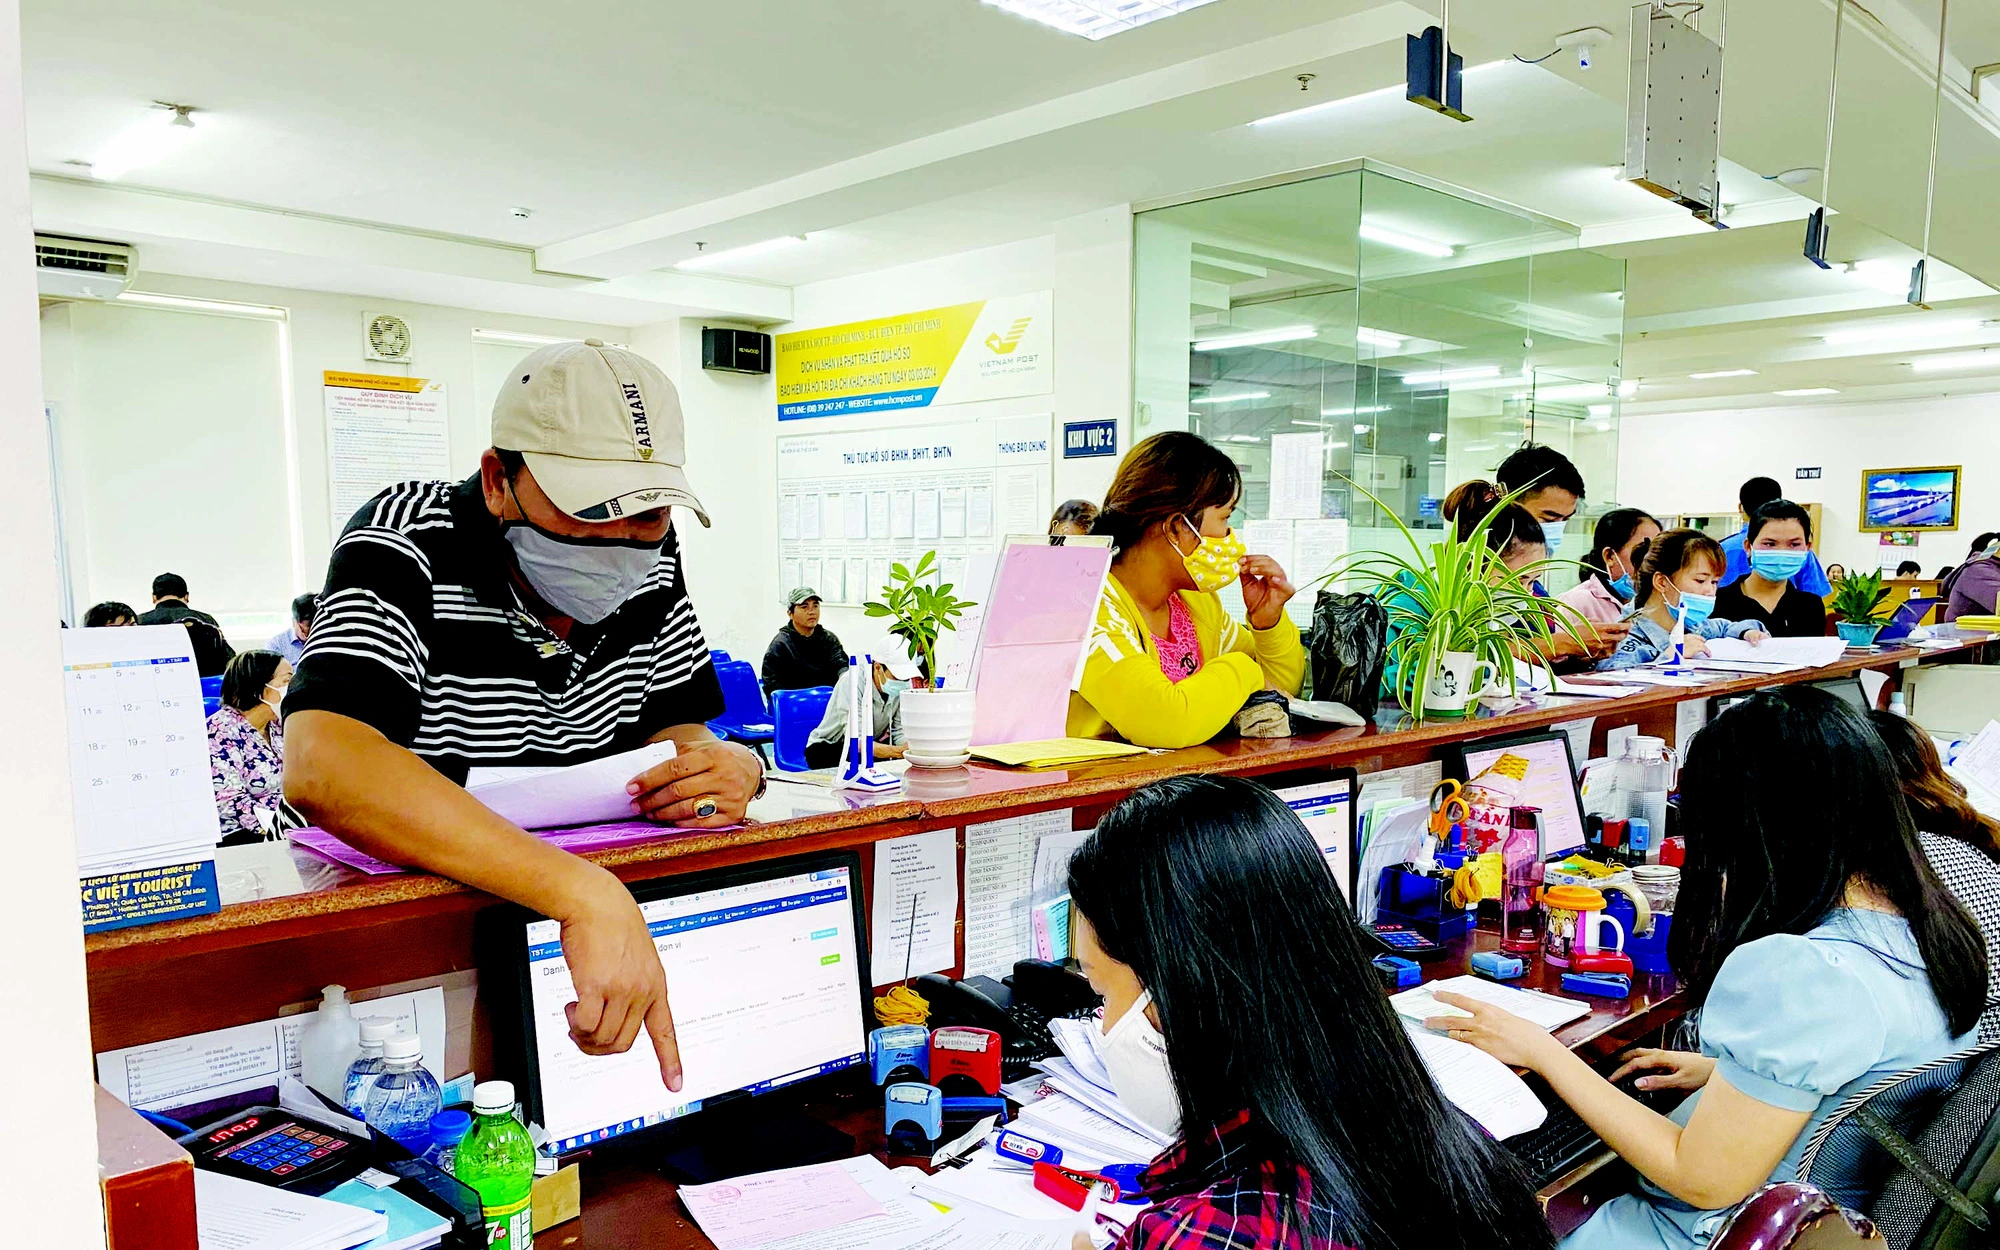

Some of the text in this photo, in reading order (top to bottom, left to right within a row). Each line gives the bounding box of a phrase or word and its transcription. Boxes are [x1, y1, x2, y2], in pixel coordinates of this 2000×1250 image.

[978, 354, 1039, 368] VIETNAM POST
[817, 403, 825, 412] 39
[825, 402, 834, 412] 247
[834, 401, 844, 410] 247
[622, 383, 652, 448] ARMANI
[1028, 440, 1046, 452] CHUNG
[1067, 426, 1113, 452] KHU VỰC 2
[933, 445, 952, 459] BHTN
[154, 666, 160, 674] 6
[82, 707, 92, 715] 11
[122, 703, 133, 712] 12
[161, 700, 171, 708] 13
[88, 734, 176, 751] 18 19 20
[91, 768, 180, 786] 25 26 27
[96, 882, 130, 900] VIỆT
[132, 874, 192, 895] TOURIST
[530, 948, 545, 957] TST
[543, 965, 566, 976] Danh
